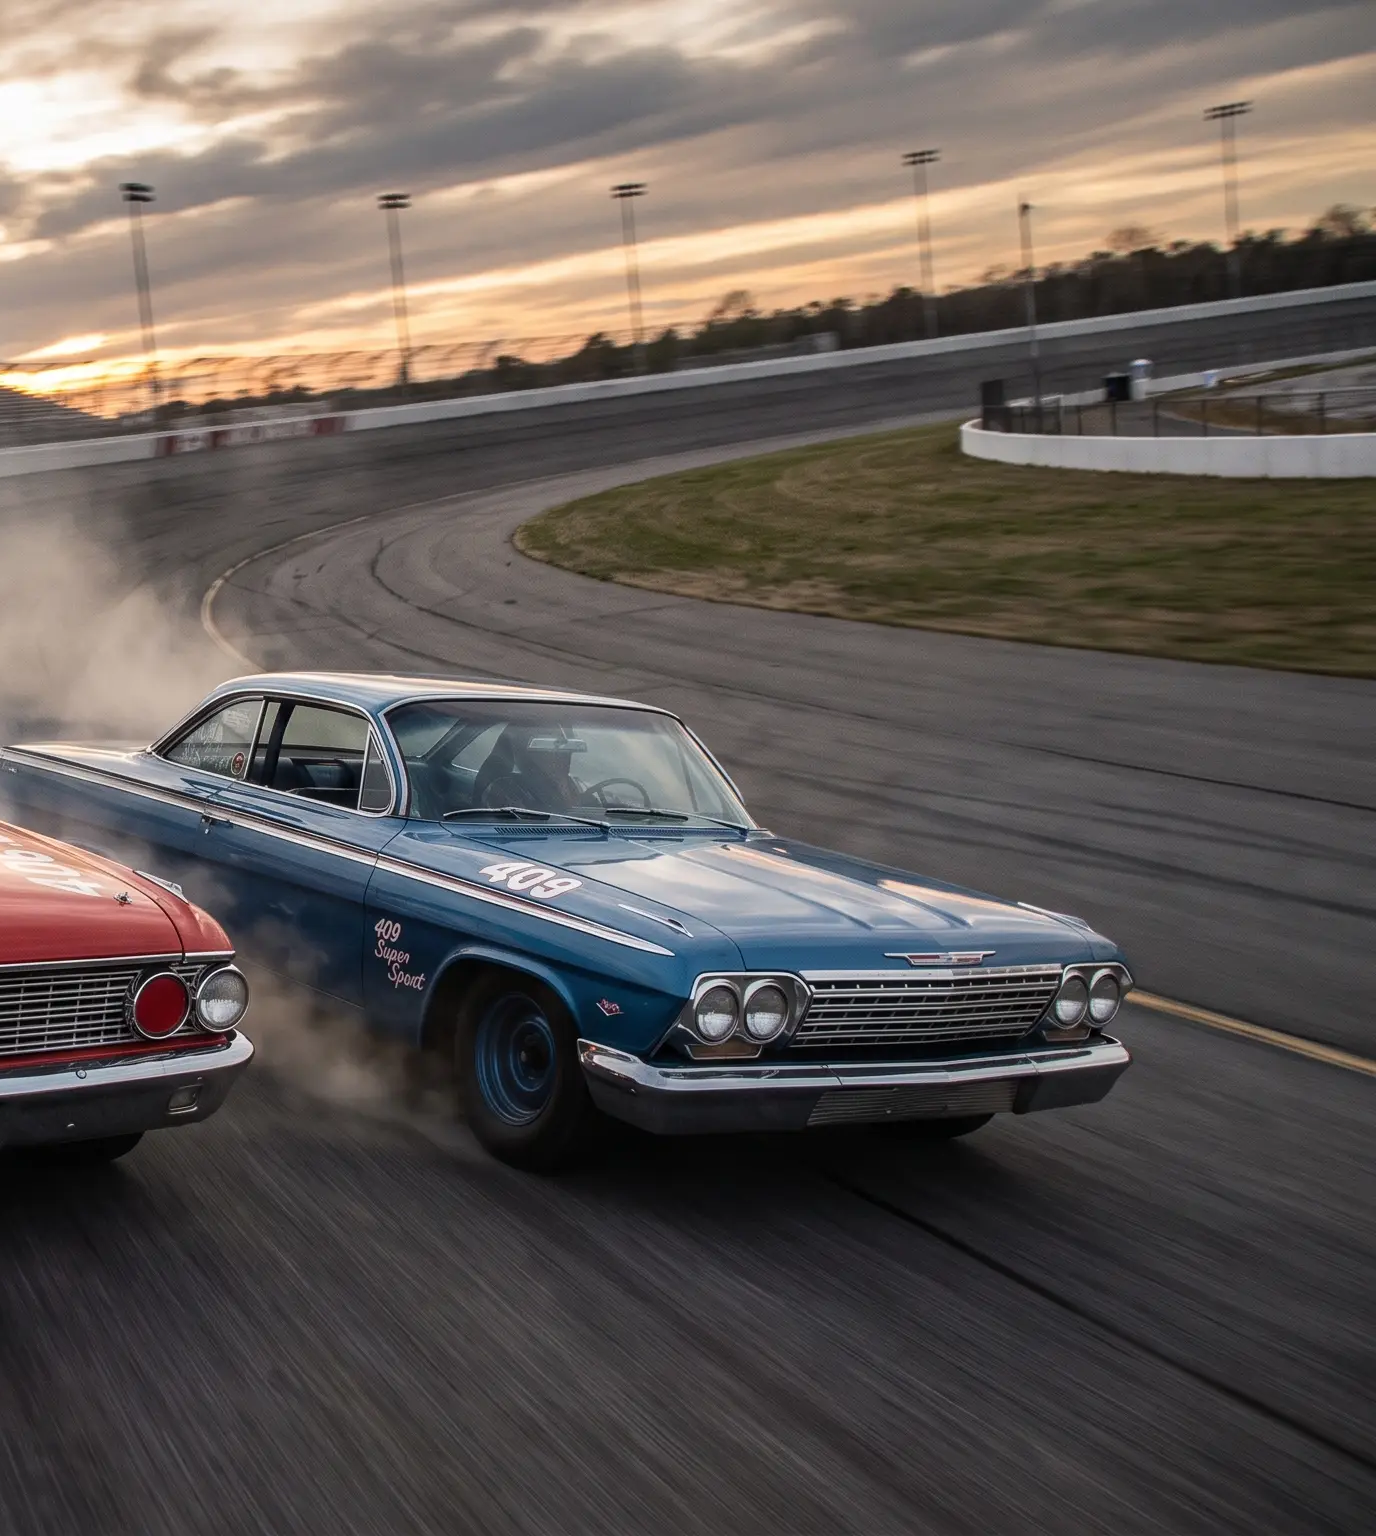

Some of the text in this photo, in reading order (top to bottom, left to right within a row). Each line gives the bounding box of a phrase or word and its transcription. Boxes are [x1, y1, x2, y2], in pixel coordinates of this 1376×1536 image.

[478, 862, 583, 899] 409
[374, 918, 401, 943] 409
[374, 939, 410, 966] Super
[387, 963, 426, 991] Sport
